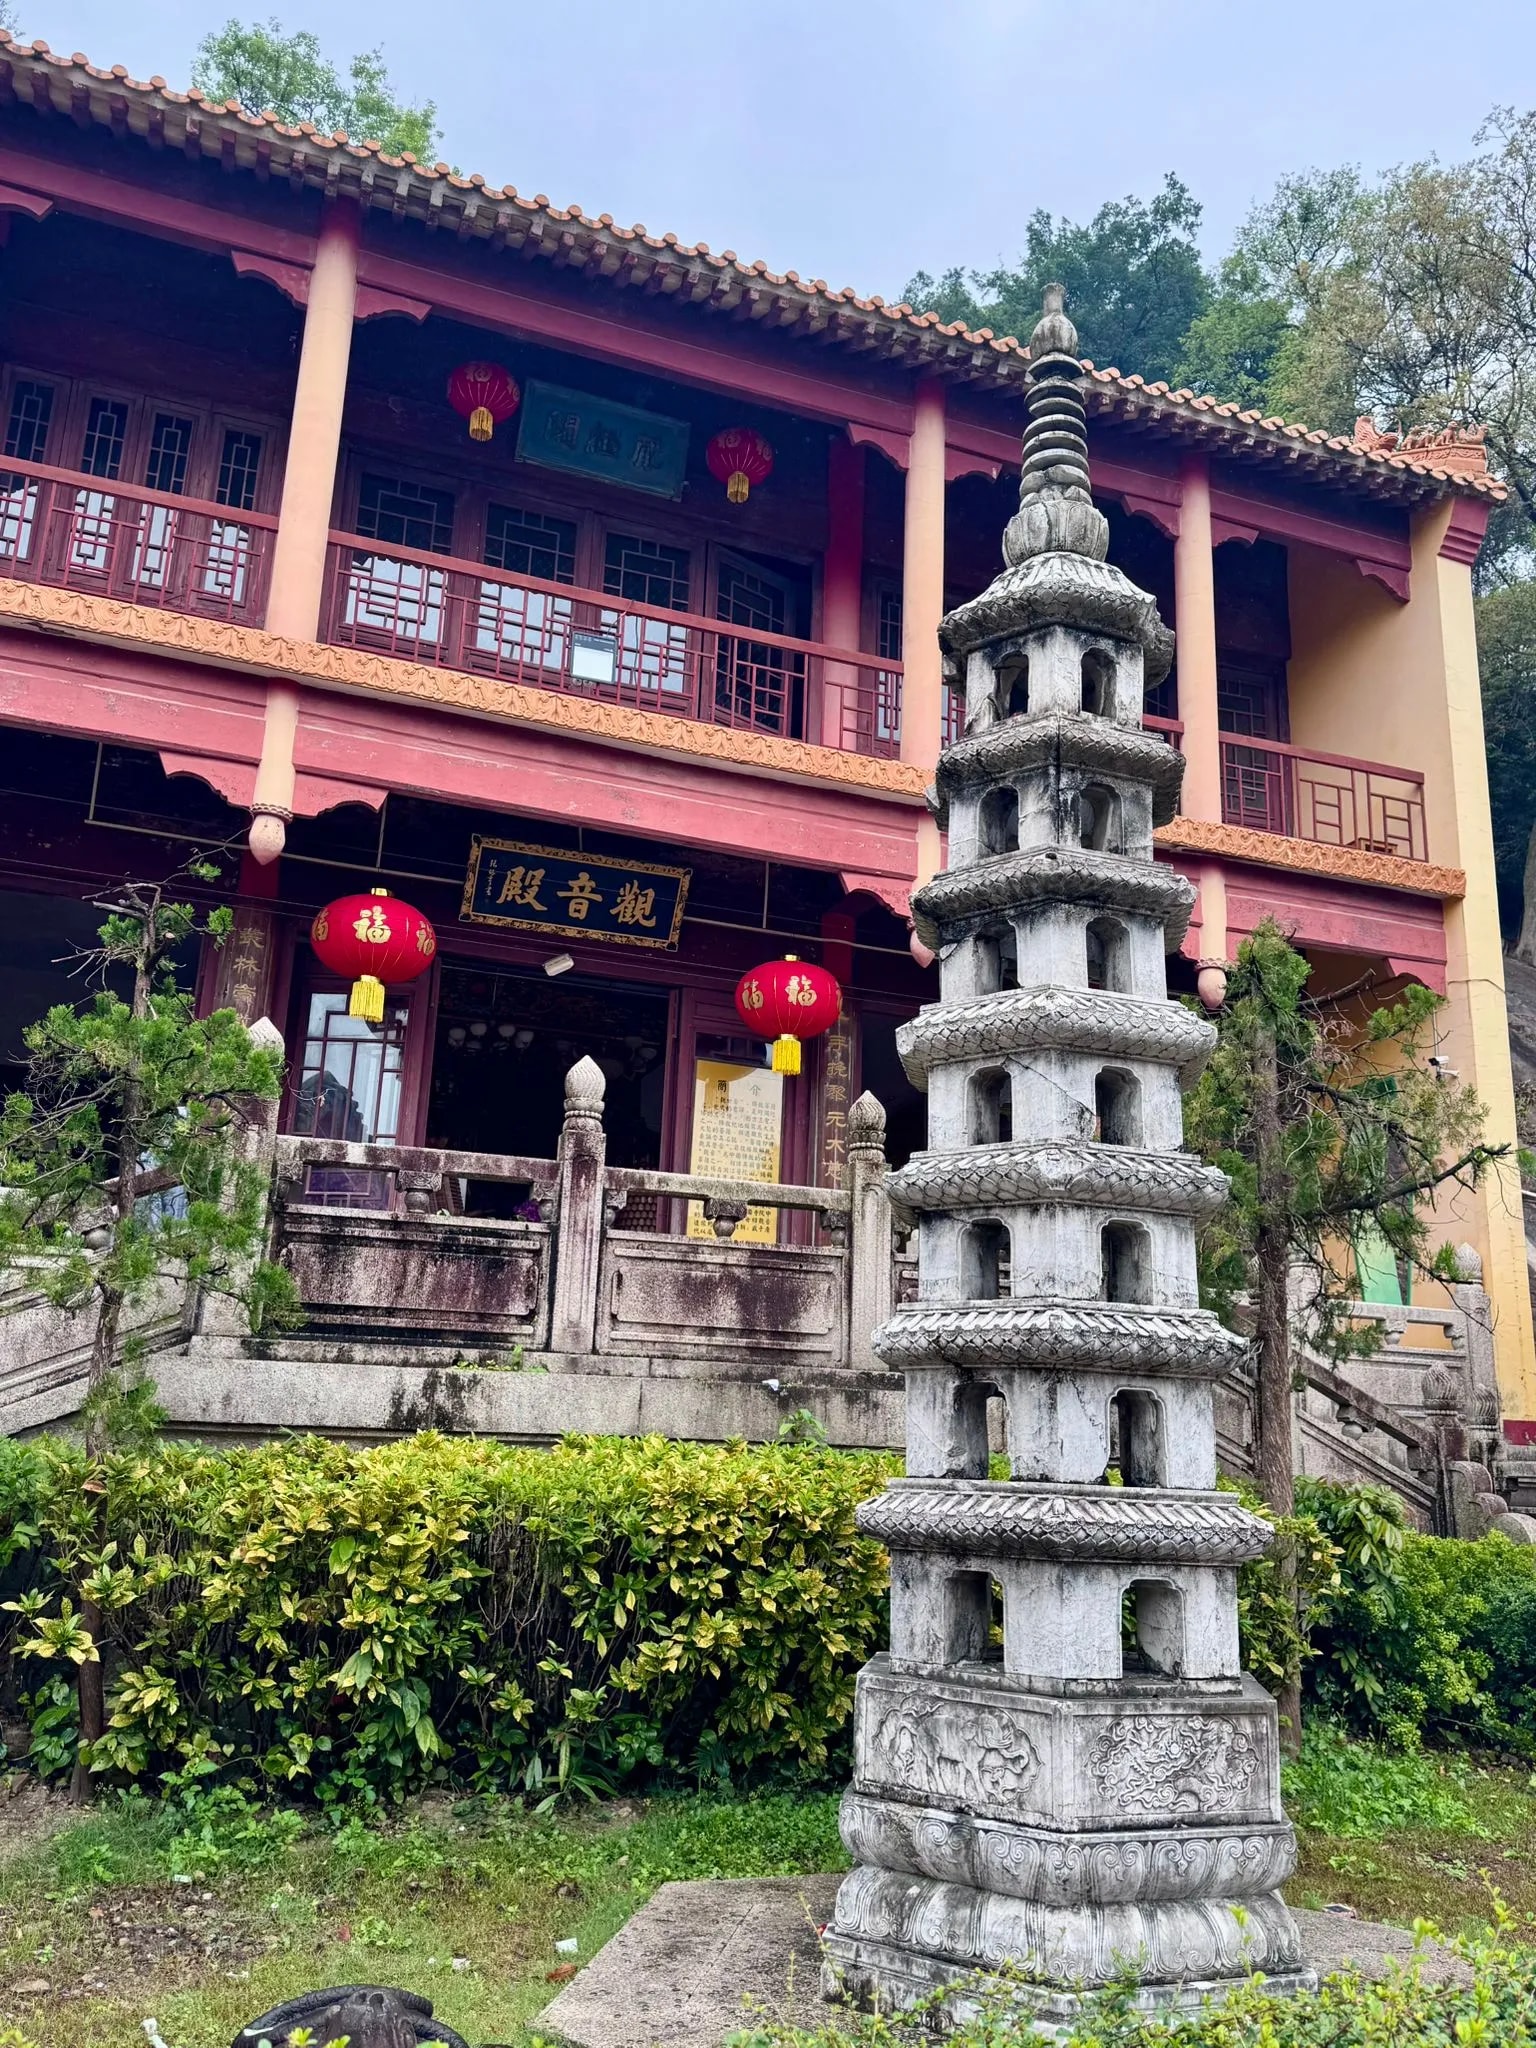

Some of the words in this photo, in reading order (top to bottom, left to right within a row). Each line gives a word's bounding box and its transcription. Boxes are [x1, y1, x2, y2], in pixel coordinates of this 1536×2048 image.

[496, 866, 656, 928] 觀音殿
[311, 909, 329, 942] 福
[352, 905, 392, 944] 福
[416, 920, 435, 956] 福
[741, 979, 764, 1010] 福
[784, 974, 818, 1007] 福
